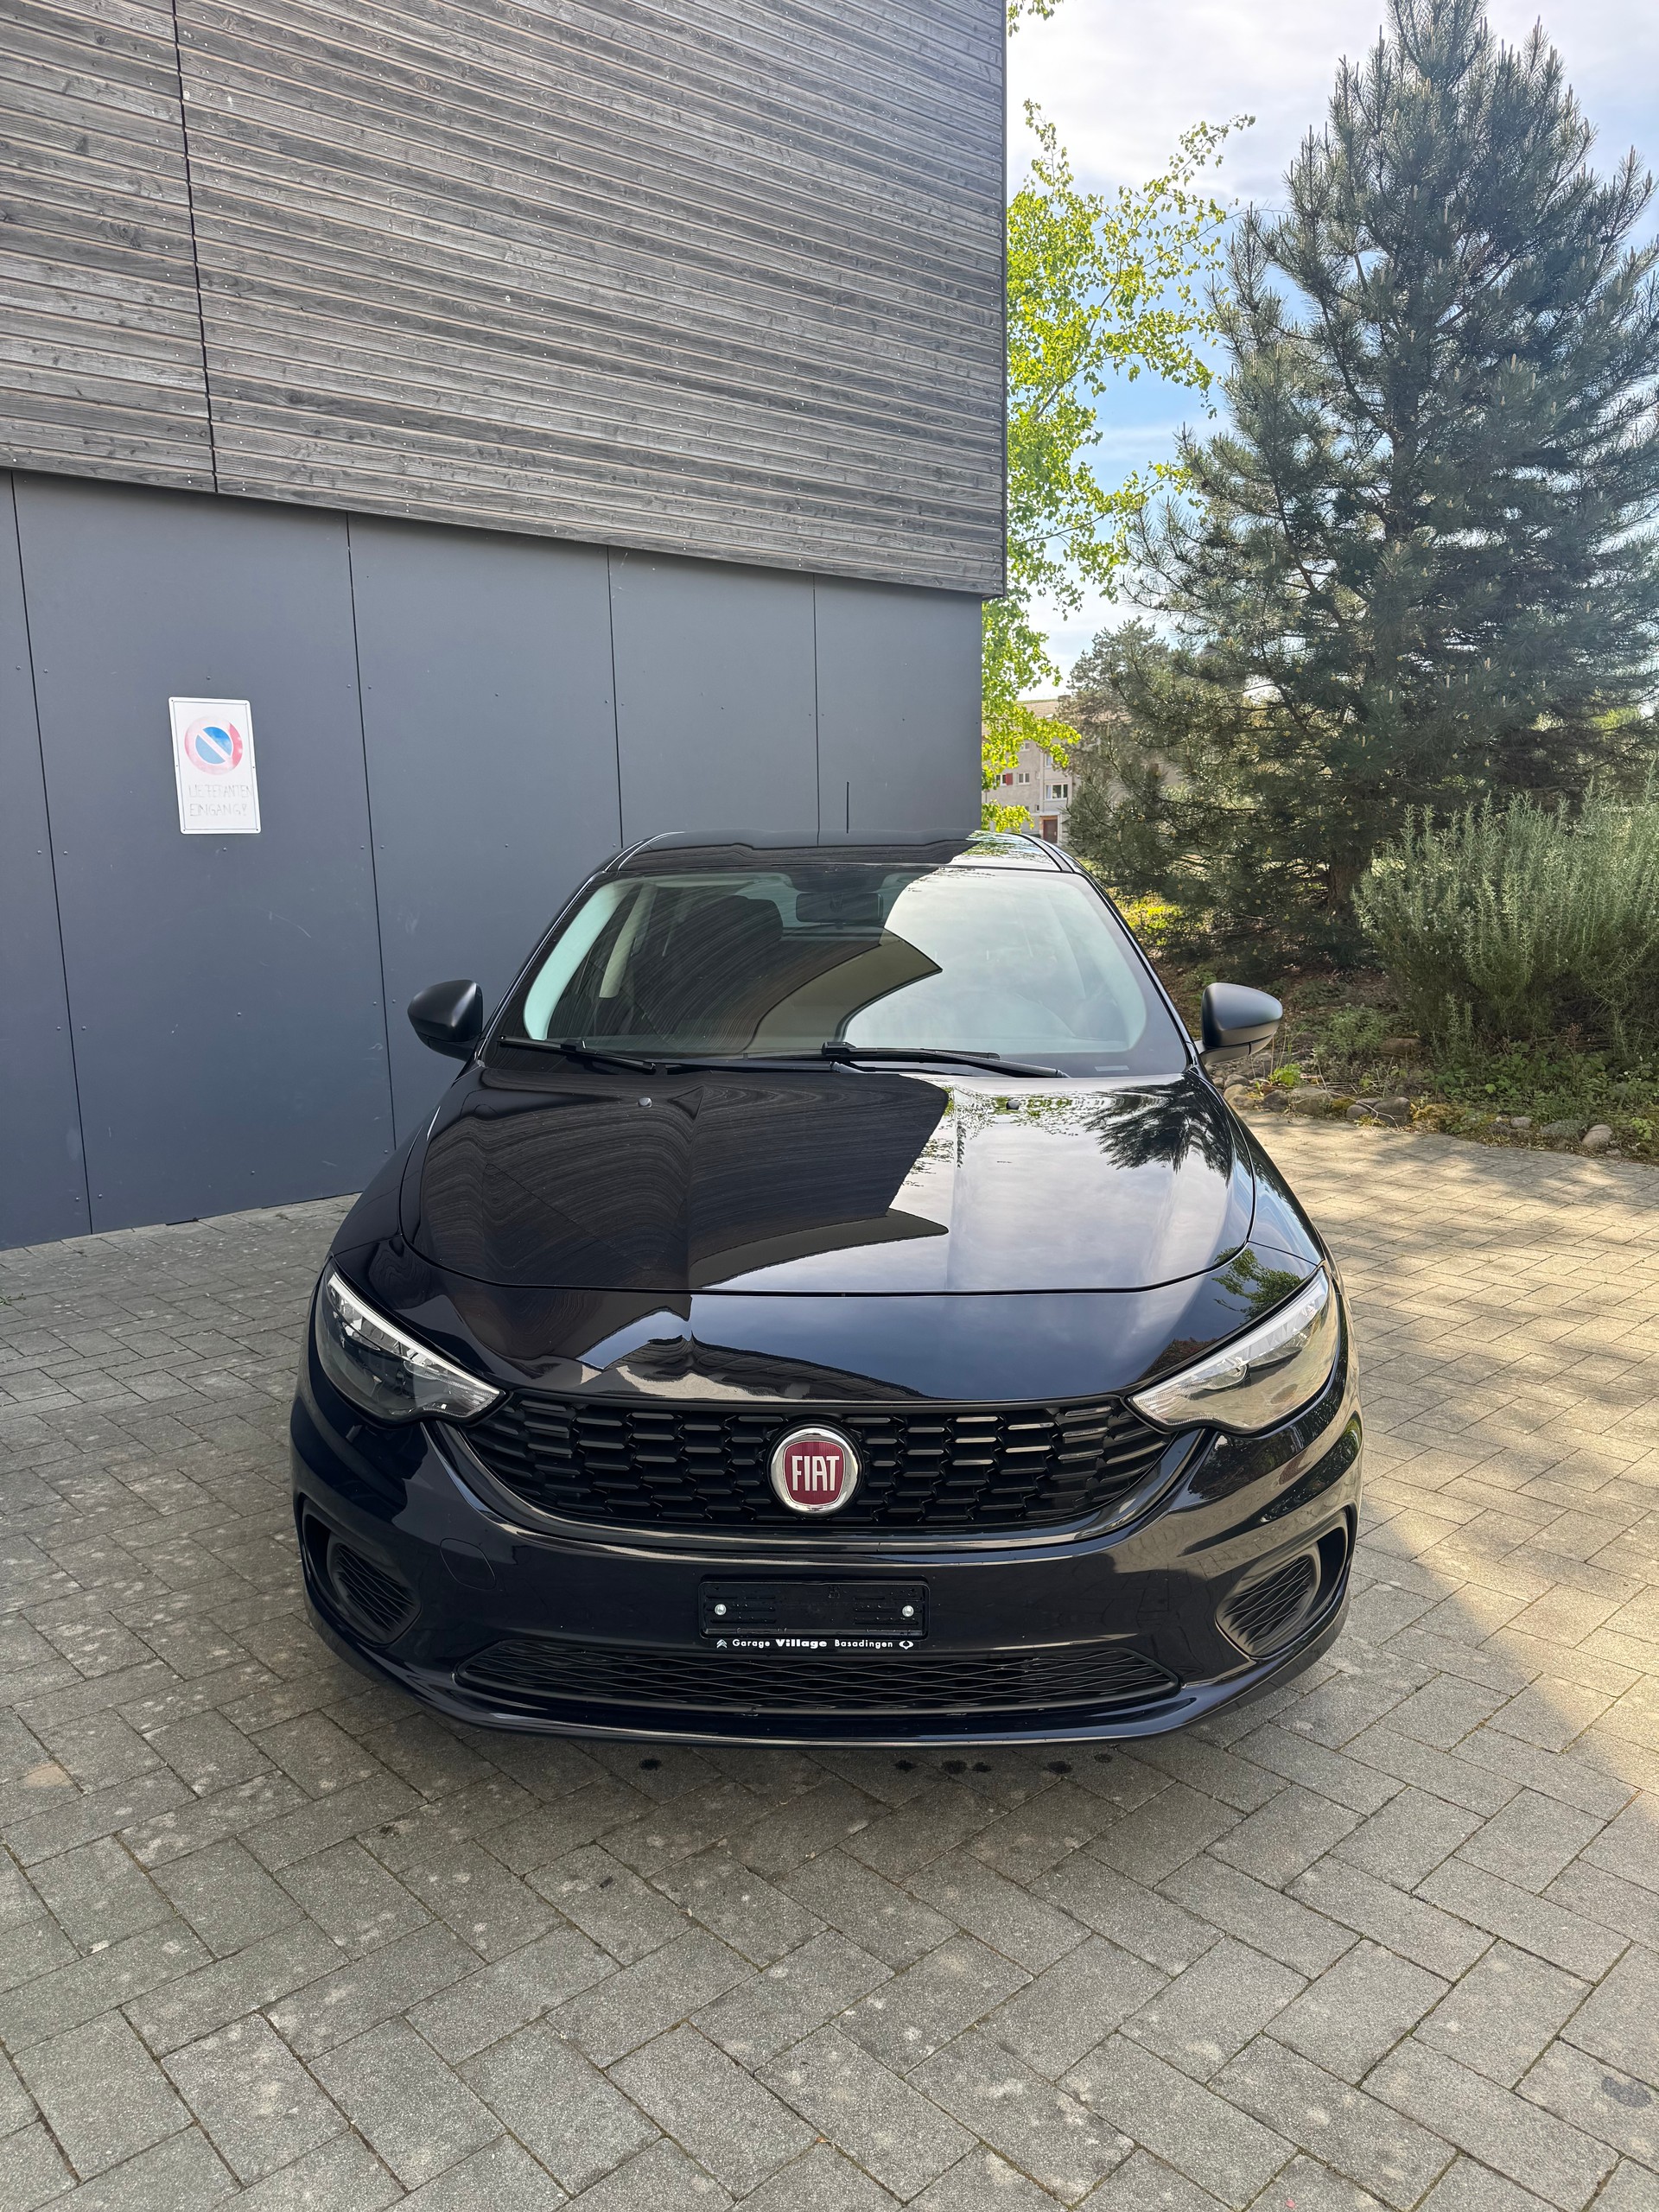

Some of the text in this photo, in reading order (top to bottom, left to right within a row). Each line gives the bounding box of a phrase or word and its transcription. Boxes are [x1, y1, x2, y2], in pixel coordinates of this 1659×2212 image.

[791, 1455, 840, 1491] FIAT
[732, 1638, 893, 1649] Garage Village Basadingen
